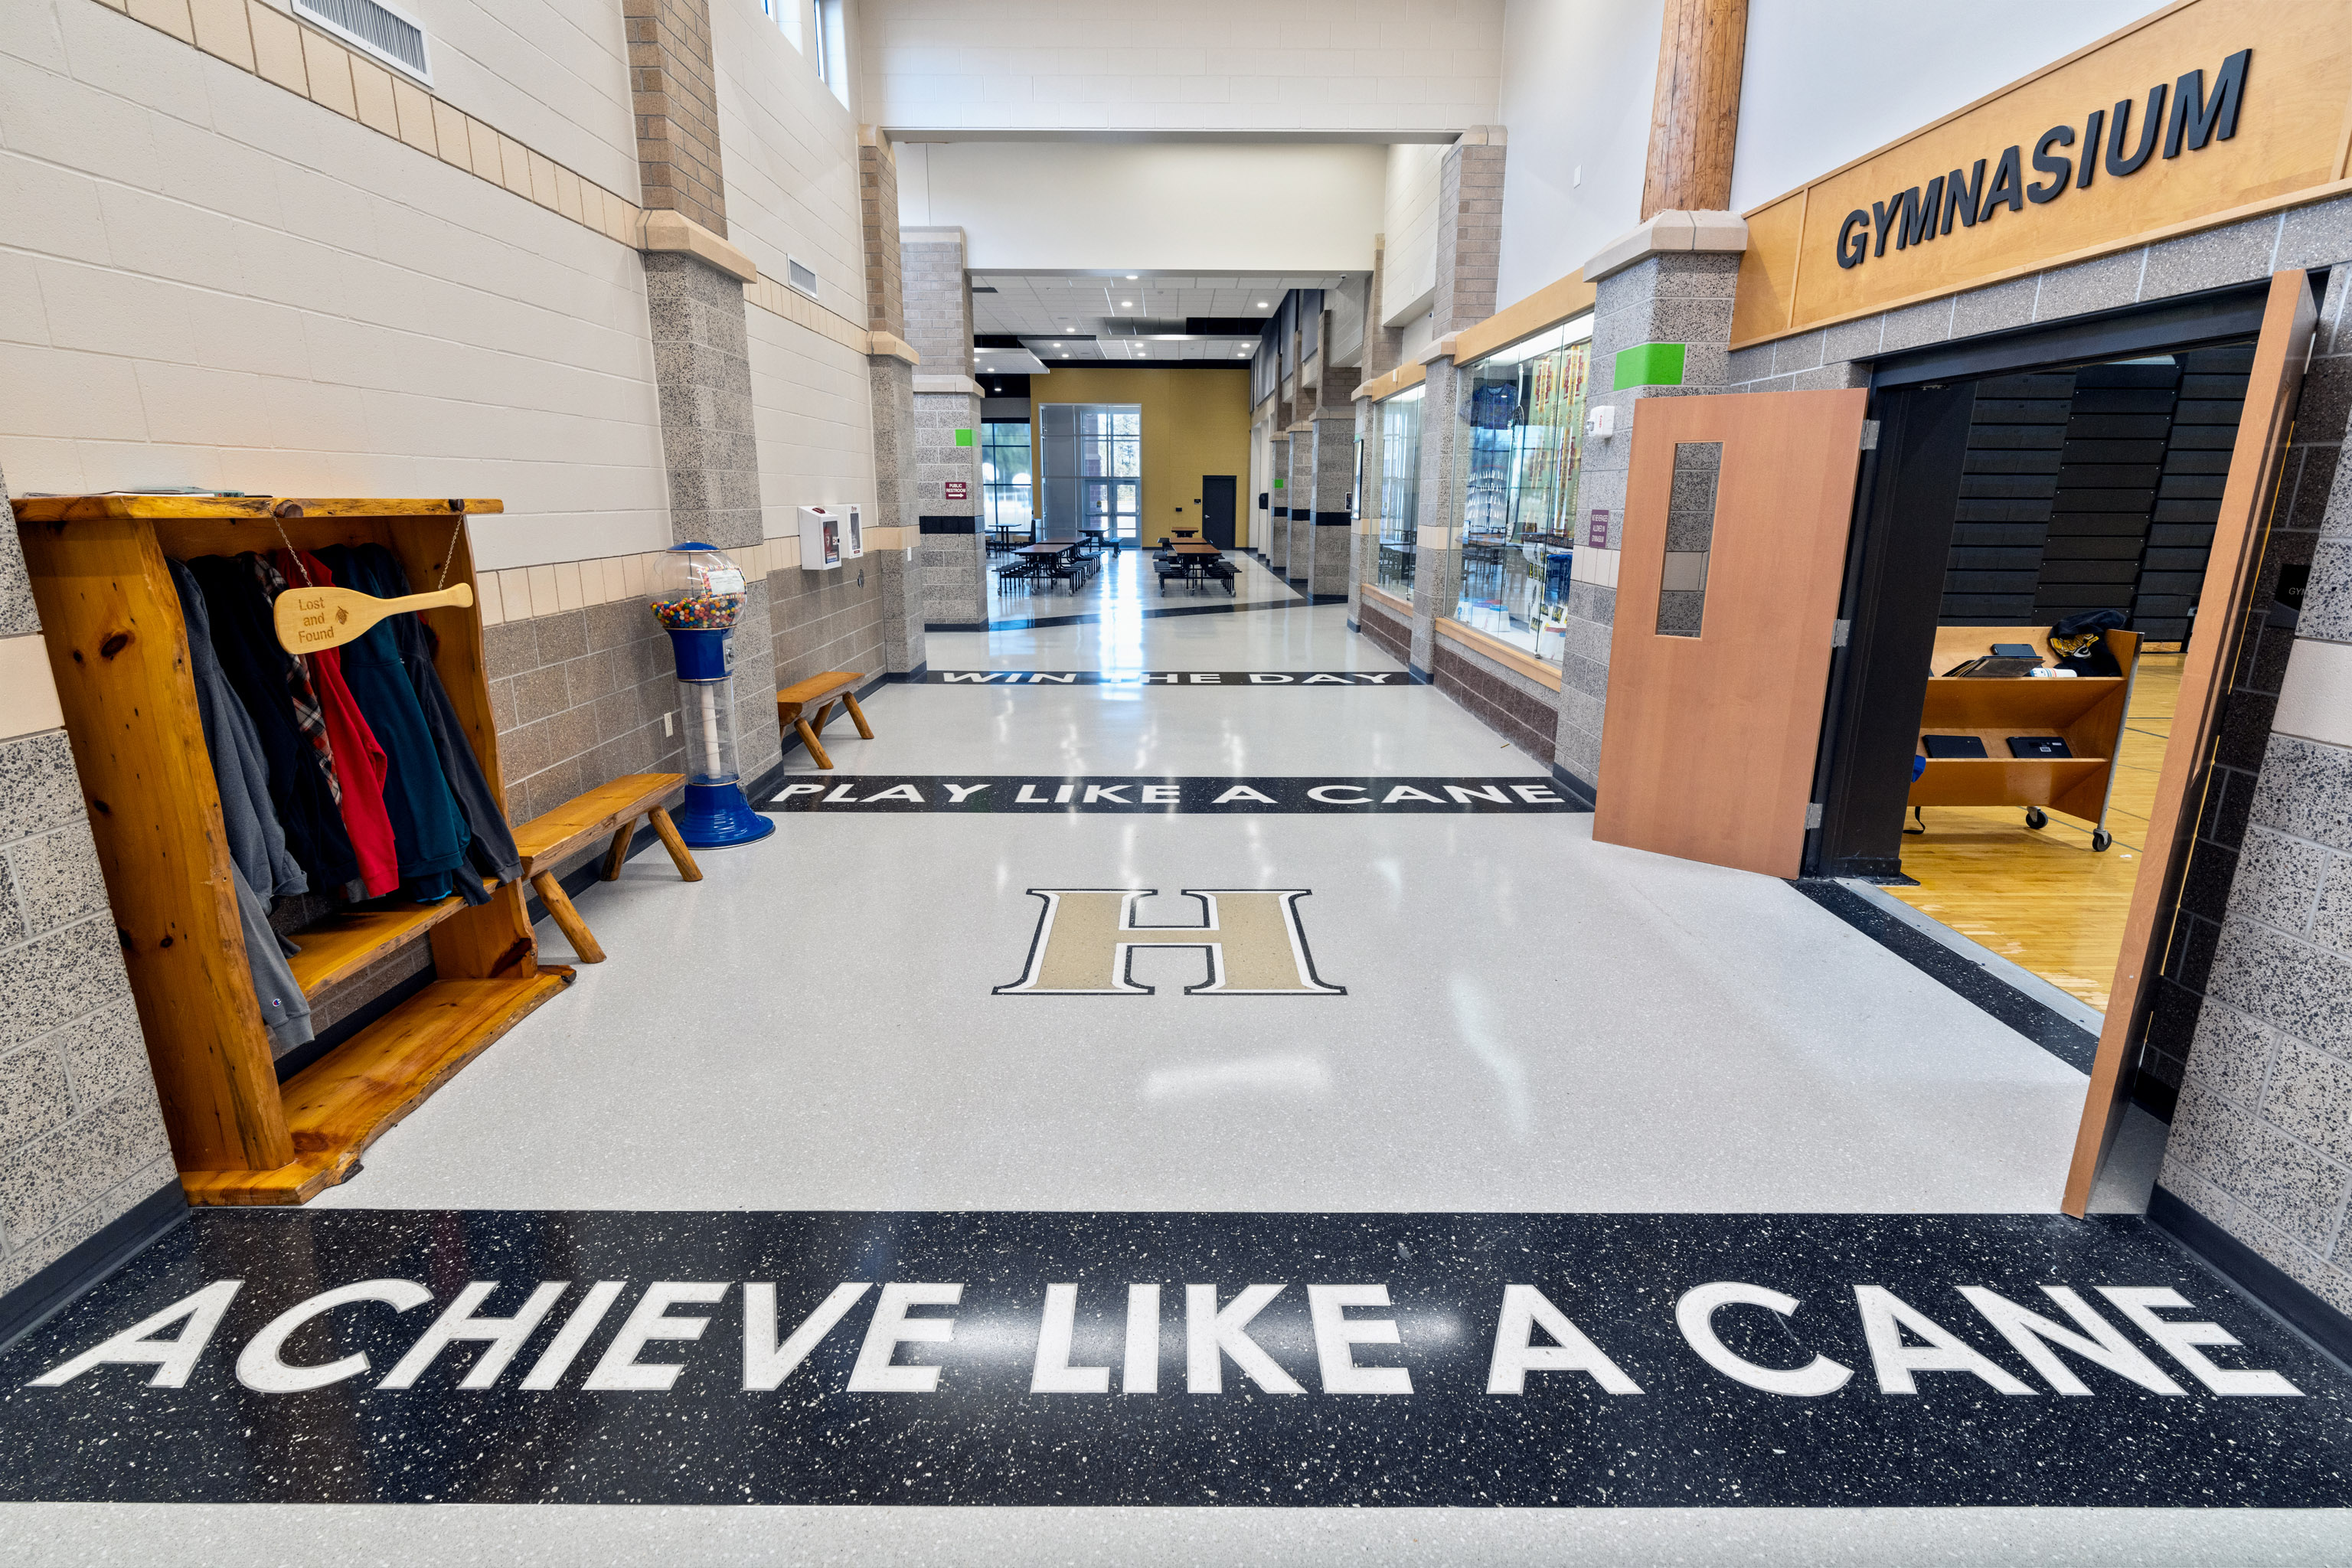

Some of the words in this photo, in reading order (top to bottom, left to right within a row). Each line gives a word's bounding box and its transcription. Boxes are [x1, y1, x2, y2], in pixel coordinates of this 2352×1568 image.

[1837, 48, 2252, 270] GYMNASIUM
[299, 597, 325, 611] Lost
[303, 612, 325, 626] and
[298, 626, 334, 643] Found
[943, 673, 1076, 683] WIN
[1100, 674, 1221, 684] THE
[1249, 674, 1391, 684] DAY
[770, 784, 991, 802] PLAY
[1014, 785, 1181, 803] LIKE
[1212, 786, 1279, 804] A
[1307, 786, 1565, 804] CANE
[991, 889, 1348, 996] H
[23, 1279, 963, 1395] ACHIEVE
[1030, 1282, 1415, 1396] LIKE
[1486, 1283, 1646, 1396] A
[1675, 1281, 2306, 1398] CANE
